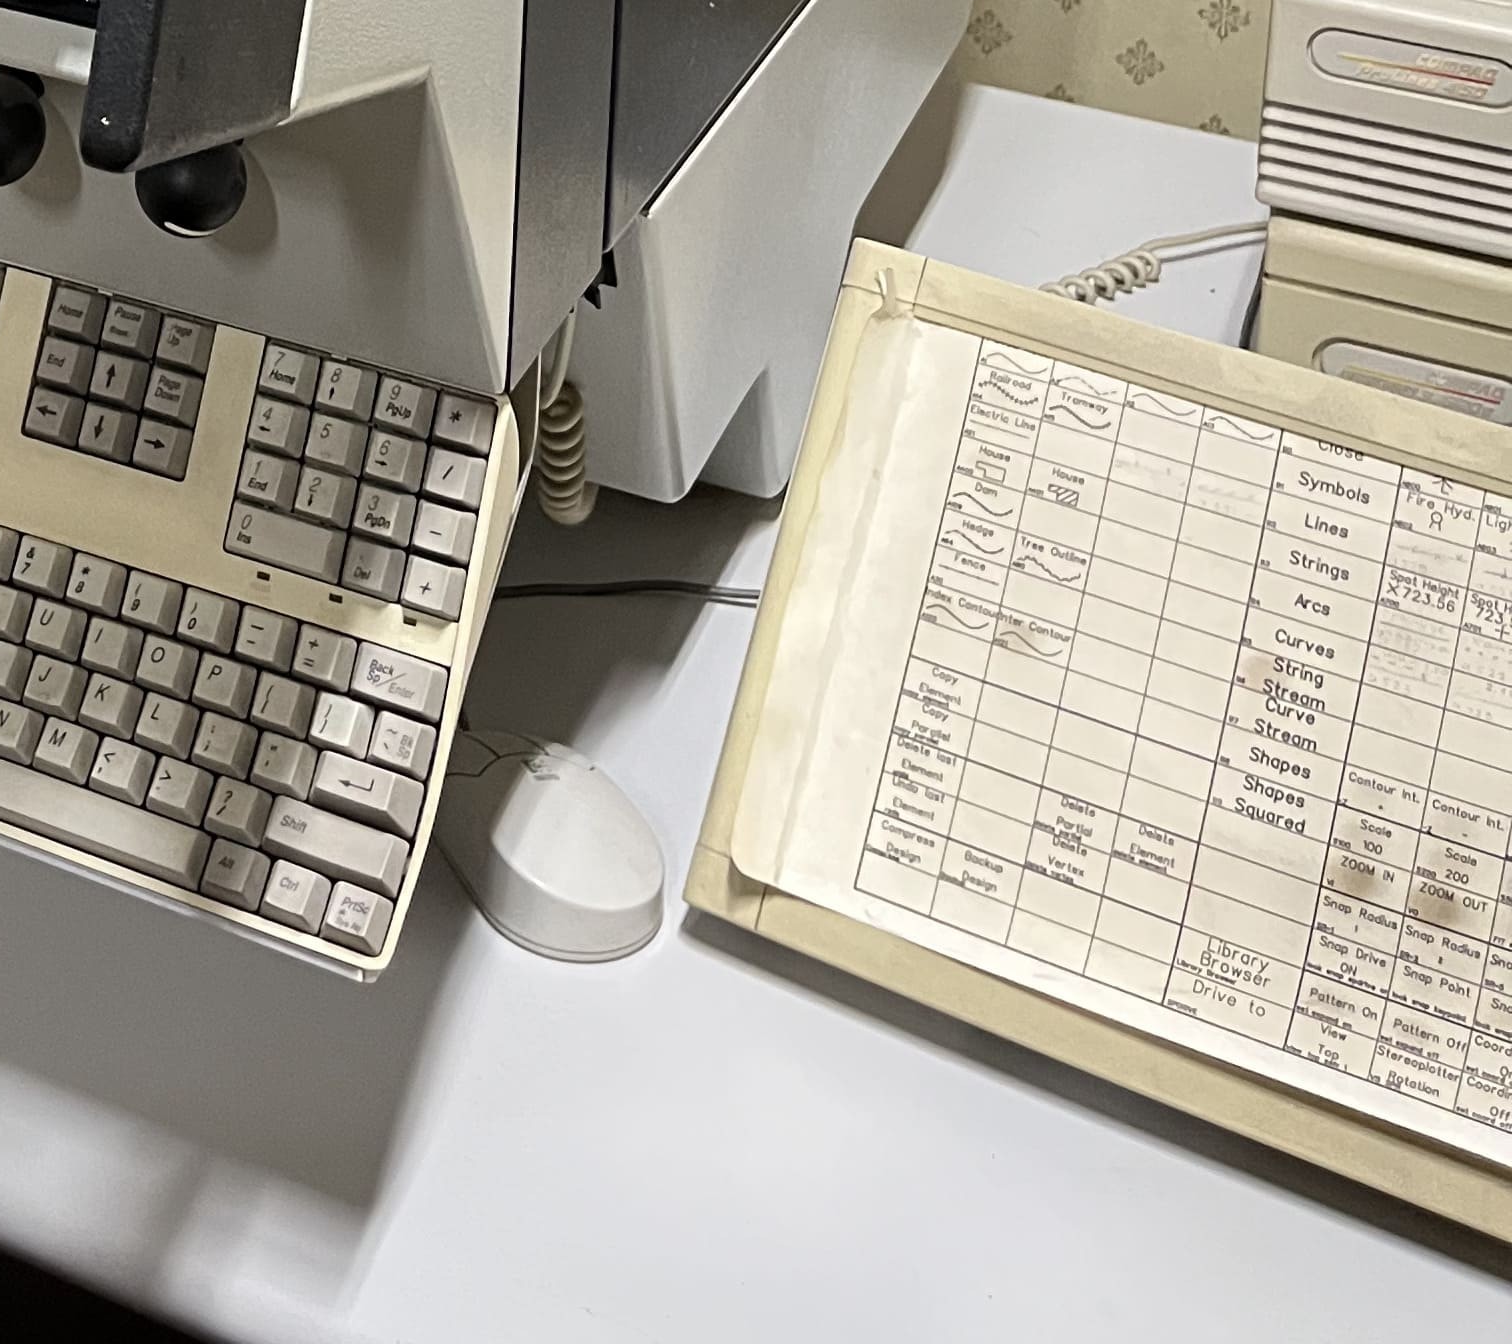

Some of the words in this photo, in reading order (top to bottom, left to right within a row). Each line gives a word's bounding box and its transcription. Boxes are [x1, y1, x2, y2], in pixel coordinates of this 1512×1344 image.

[47, 353, 65, 368] End
[268, 369, 296, 386] Home
[330, 368, 342, 383] 8
[389, 385, 401, 400] 9
[262, 407, 272, 422] 4
[385, 402, 412, 419] PgUp
[320, 422, 333, 439] 5
[379, 439, 391, 456] 6
[979, 445, 1010, 462] House
[248, 477, 269, 492] End
[308, 476, 322, 493] 2
[1052, 467, 1084, 484] House
[975, 482, 997, 496] Dam
[1298, 470, 1371, 505] Symbols
[1406, 491, 1435, 510] Fire
[364, 513, 391, 529] PgDn
[1304, 512, 1349, 539] Lines
[1289, 550, 1350, 581] Strings
[1389, 569, 1418, 587] Spot
[1422, 579, 1460, 599] Height
[1294, 593, 1331, 617] Arcs
[1470, 593, 1499, 611] Spot
[40, 609, 54, 626] U
[151, 647, 165, 662] O
[1275, 629, 1335, 659] Curves
[207, 665, 222, 680] P
[1273, 657, 1324, 689] String
[94, 683, 112, 702] K
[1263, 679, 1325, 711] Stream
[1265, 697, 1315, 725] Curve
[48, 728, 68, 748] M
[1254, 718, 1317, 752] Stream
[1249, 747, 1311, 779] Shapes
[1243, 775, 1305, 808] Shapes
[1349, 772, 1396, 795] Contour
[1234, 797, 1305, 834] Squared
[1433, 800, 1480, 822] Contour
[280, 815, 308, 834] Shift
[1360, 819, 1392, 838] Scale
[1364, 840, 1382, 855] 100
[1445, 848, 1477, 866] Scale
[1340, 855, 1375, 875] ZOOM
[1383, 870, 1394, 883] IN
[1445, 869, 1469, 884] 200
[1420, 881, 1454, 901] ZOOM
[1463, 897, 1488, 912] OUT
[1323, 896, 1352, 914] Snap
[1359, 909, 1398, 930] Radius
[1319, 935, 1348, 955] Snap
[1356, 949, 1387, 967] Drive
[1405, 925, 1434, 944] Snap
[1442, 937, 1481, 959] Radius
[1207, 936, 1269, 973] Library
[1200, 951, 1270, 987] Browser
[1403, 965, 1432, 985] Snap
[1440, 977, 1470, 998] Point
[1193, 979, 1237, 1006] Drive
[1249, 1000, 1265, 1017] to
[1309, 987, 1356, 1012] Pattern
[1362, 1007, 1378, 1020] On
[1320, 1023, 1347, 1041] View
[1393, 1018, 1440, 1043] Pattern
[1318, 1044, 1339, 1060] Top
[1377, 1046, 1460, 1081] Stereoplotter
[1388, 1071, 1440, 1096] Rotation
